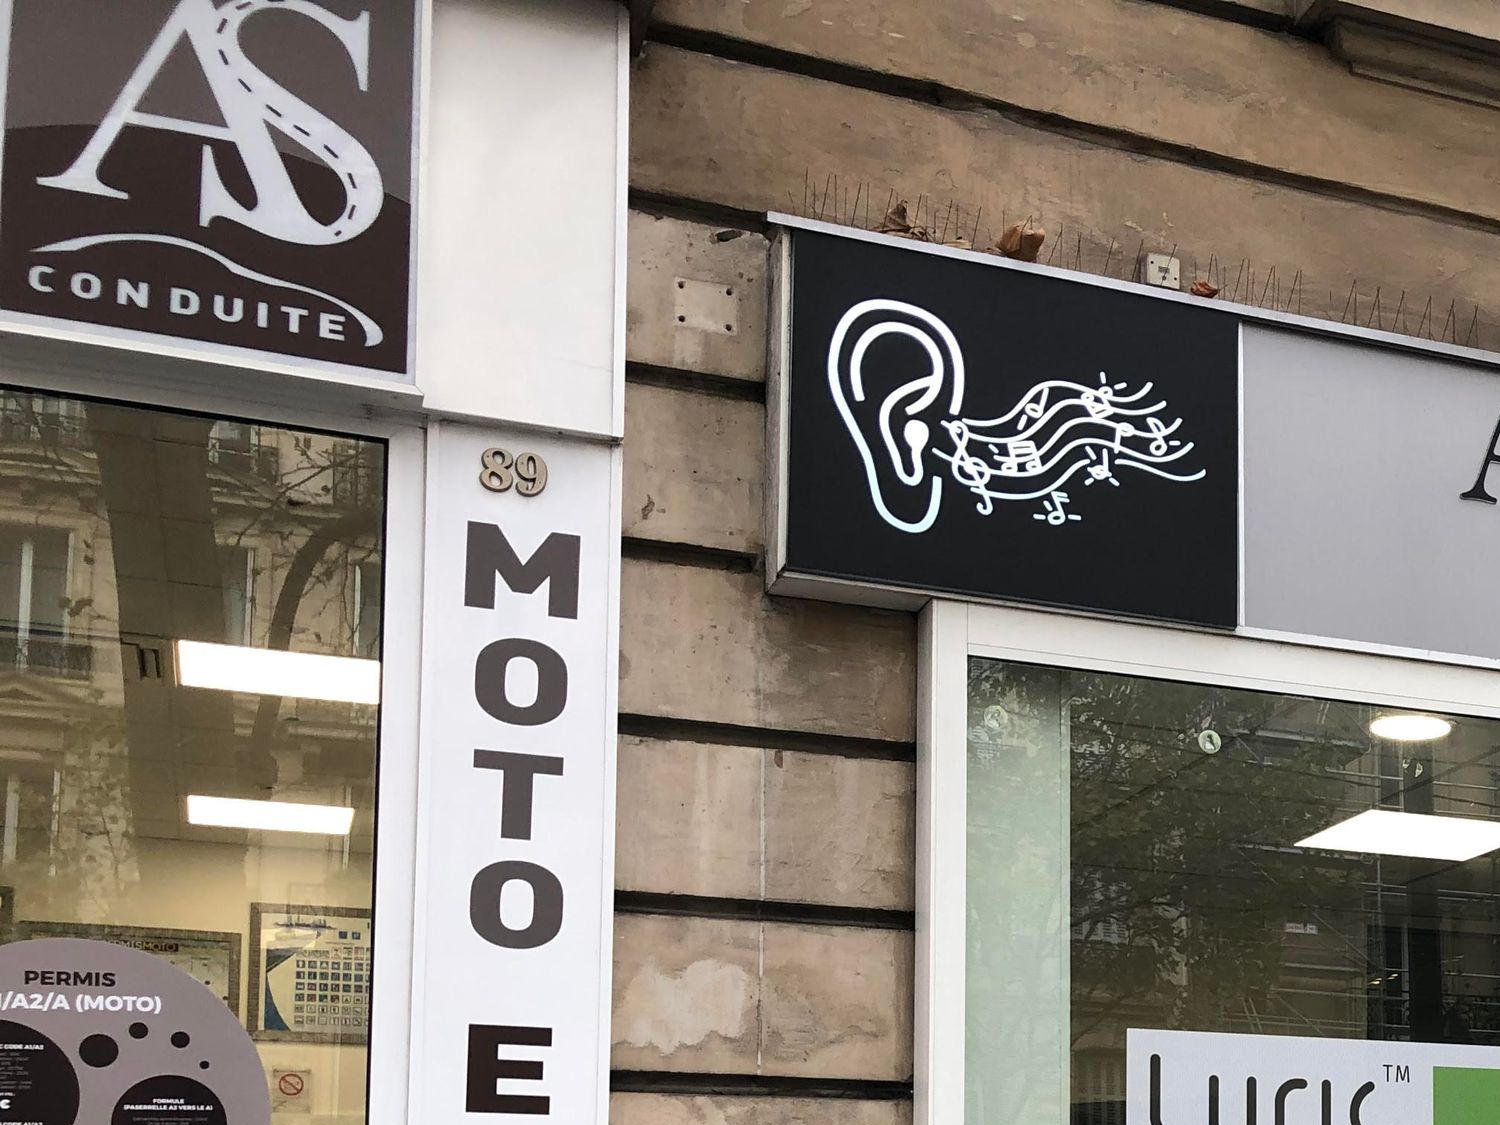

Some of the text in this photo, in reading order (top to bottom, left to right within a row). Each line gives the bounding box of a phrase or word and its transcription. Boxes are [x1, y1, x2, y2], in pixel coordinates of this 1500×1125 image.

[28, 264, 347, 342] CONDUITE
[479, 447, 548, 497] 89
[464, 520, 581, 949] MOTO
[0, 991, 162, 1014] /A2/A (MOTO)
[24, 970, 116, 987] PERMIS
